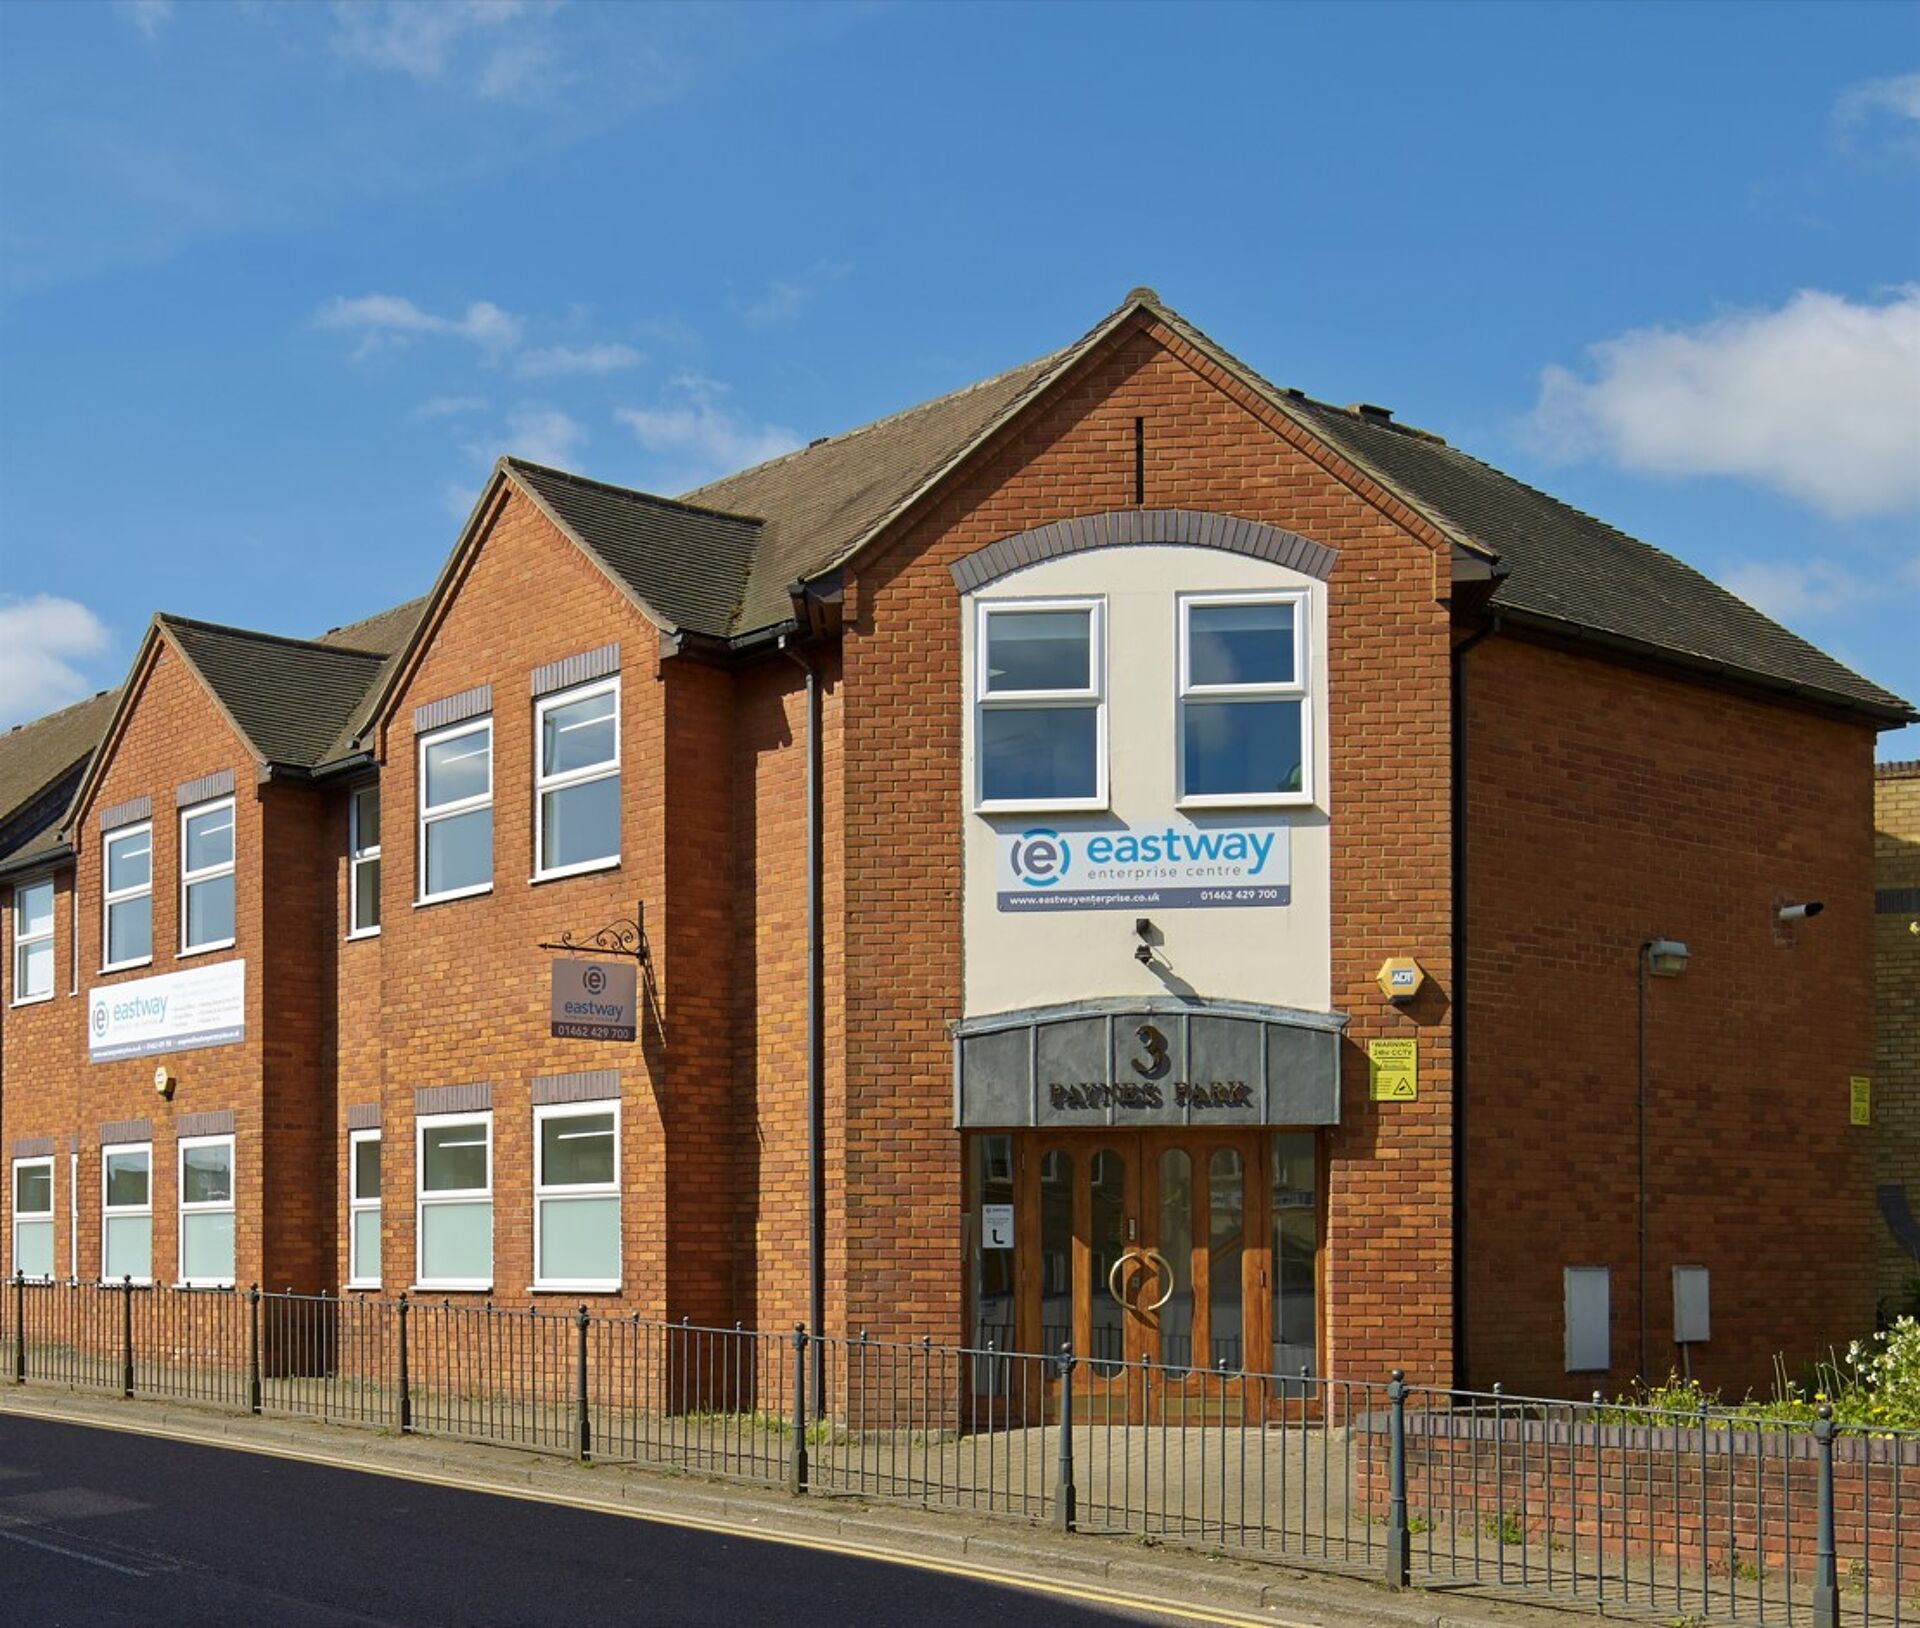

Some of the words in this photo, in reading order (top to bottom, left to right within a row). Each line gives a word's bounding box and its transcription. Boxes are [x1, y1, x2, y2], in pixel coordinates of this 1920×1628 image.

[1087, 827, 1275, 875] eastway
[1087, 867, 1178, 881] enterprise
[1186, 865, 1242, 877] centre
[1010, 892, 1160, 906] www.eastwayenterprise.co.uk
[1201, 890, 1233, 901] 01462
[1235, 889, 1255, 900] 429
[1257, 888, 1278, 900] 700
[1392, 970, 1414, 984] ADT
[113, 995, 168, 1022] eastway
[564, 1001, 624, 1022] eastway
[558, 1025, 588, 1037] 01462
[592, 1027, 609, 1038] 429
[612, 1028, 630, 1039] 700
[1131, 1024, 1167, 1078] 3
[1049, 1081, 1163, 1109] PAYNES
[1173, 1080, 1254, 1108] PARK
